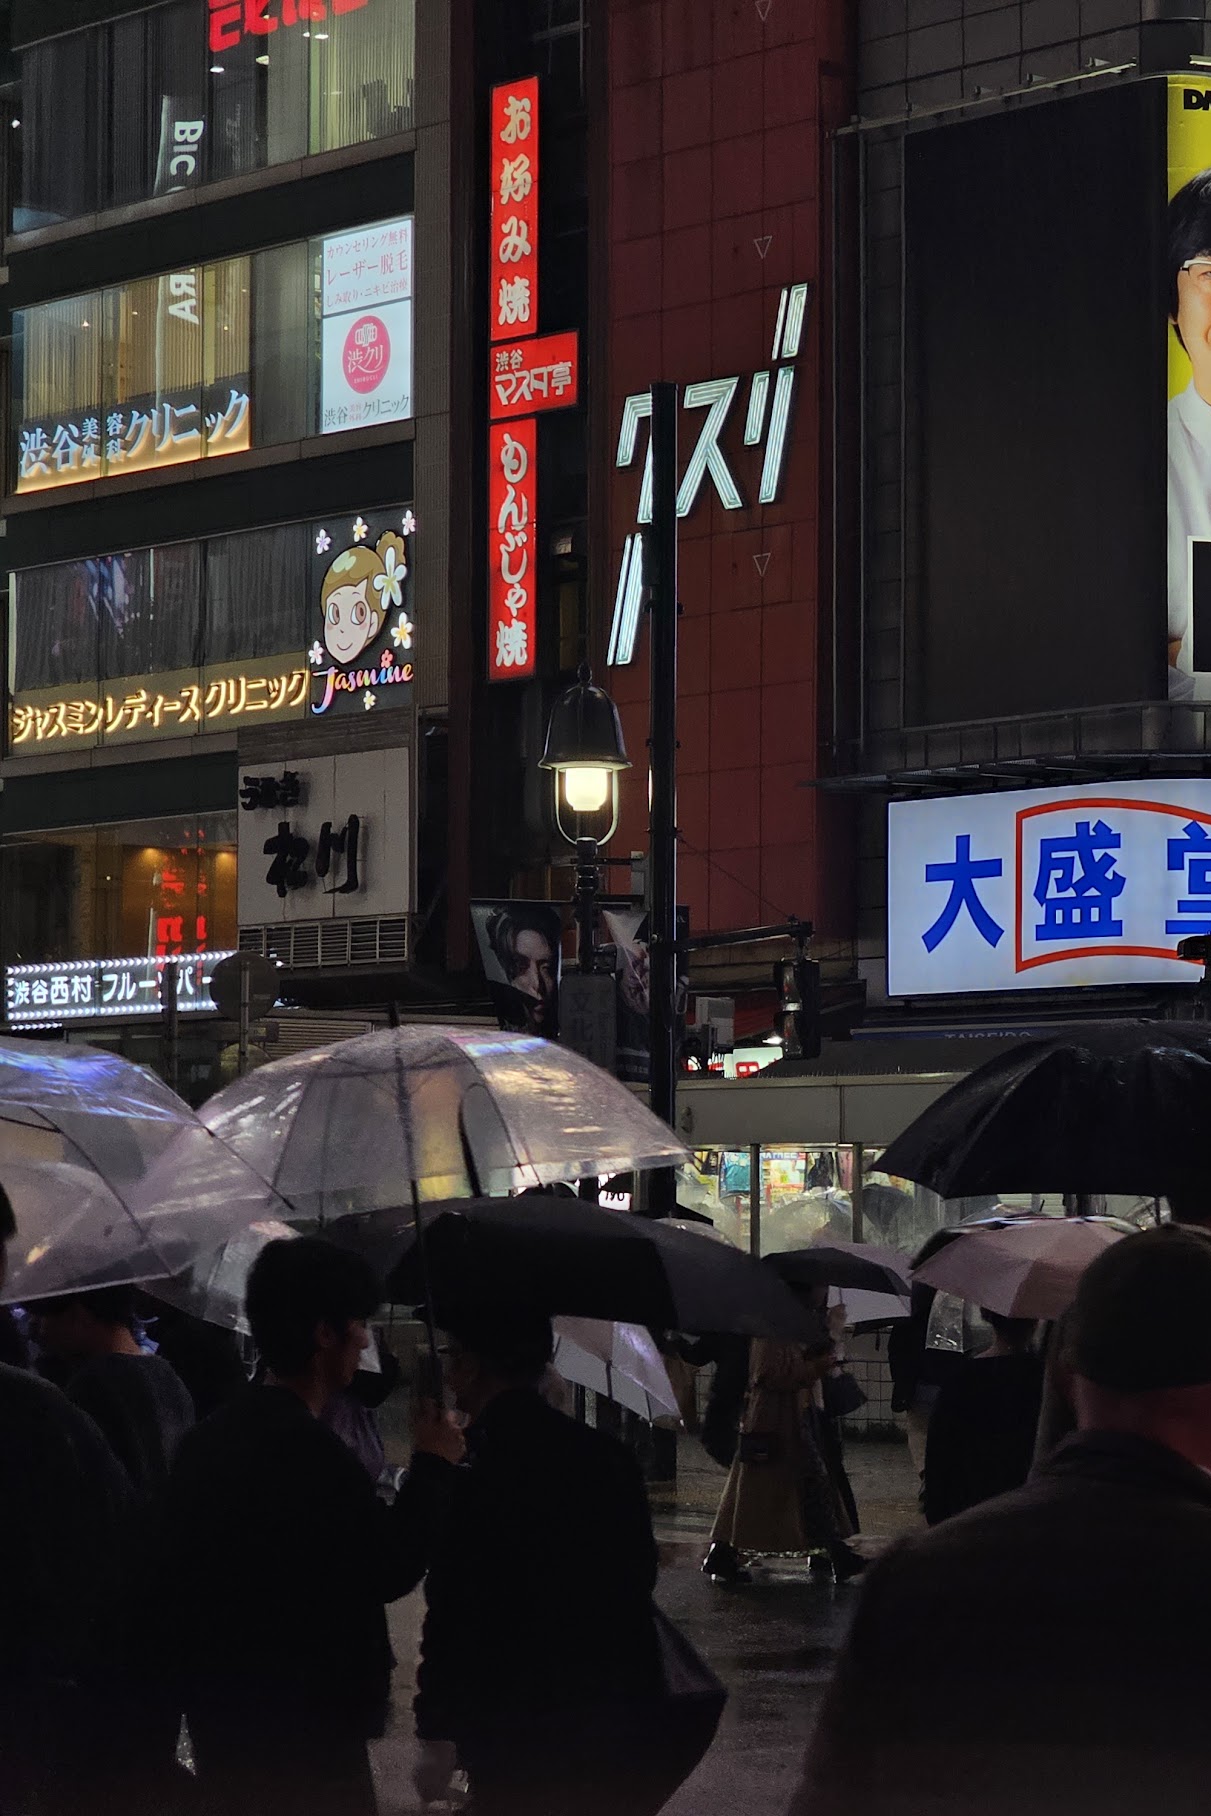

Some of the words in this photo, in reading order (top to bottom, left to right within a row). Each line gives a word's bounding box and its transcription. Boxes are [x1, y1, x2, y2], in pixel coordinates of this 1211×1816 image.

[499, 95, 532, 326] お好み焼
[327, 250, 409, 286] レーザー脱毛
[347, 345, 384, 374] 渋クリ
[496, 349, 523, 373] 渋谷
[19, 389, 250, 478] 渋谷美容外科クリニック
[496, 433, 528, 667] もんじゃ焼
[12, 669, 309, 743] ジャスミンレディースクリニック
[312, 662, 413, 715] Jasmine
[14, 966, 213, 1006] 渋谷西村フルーパー
